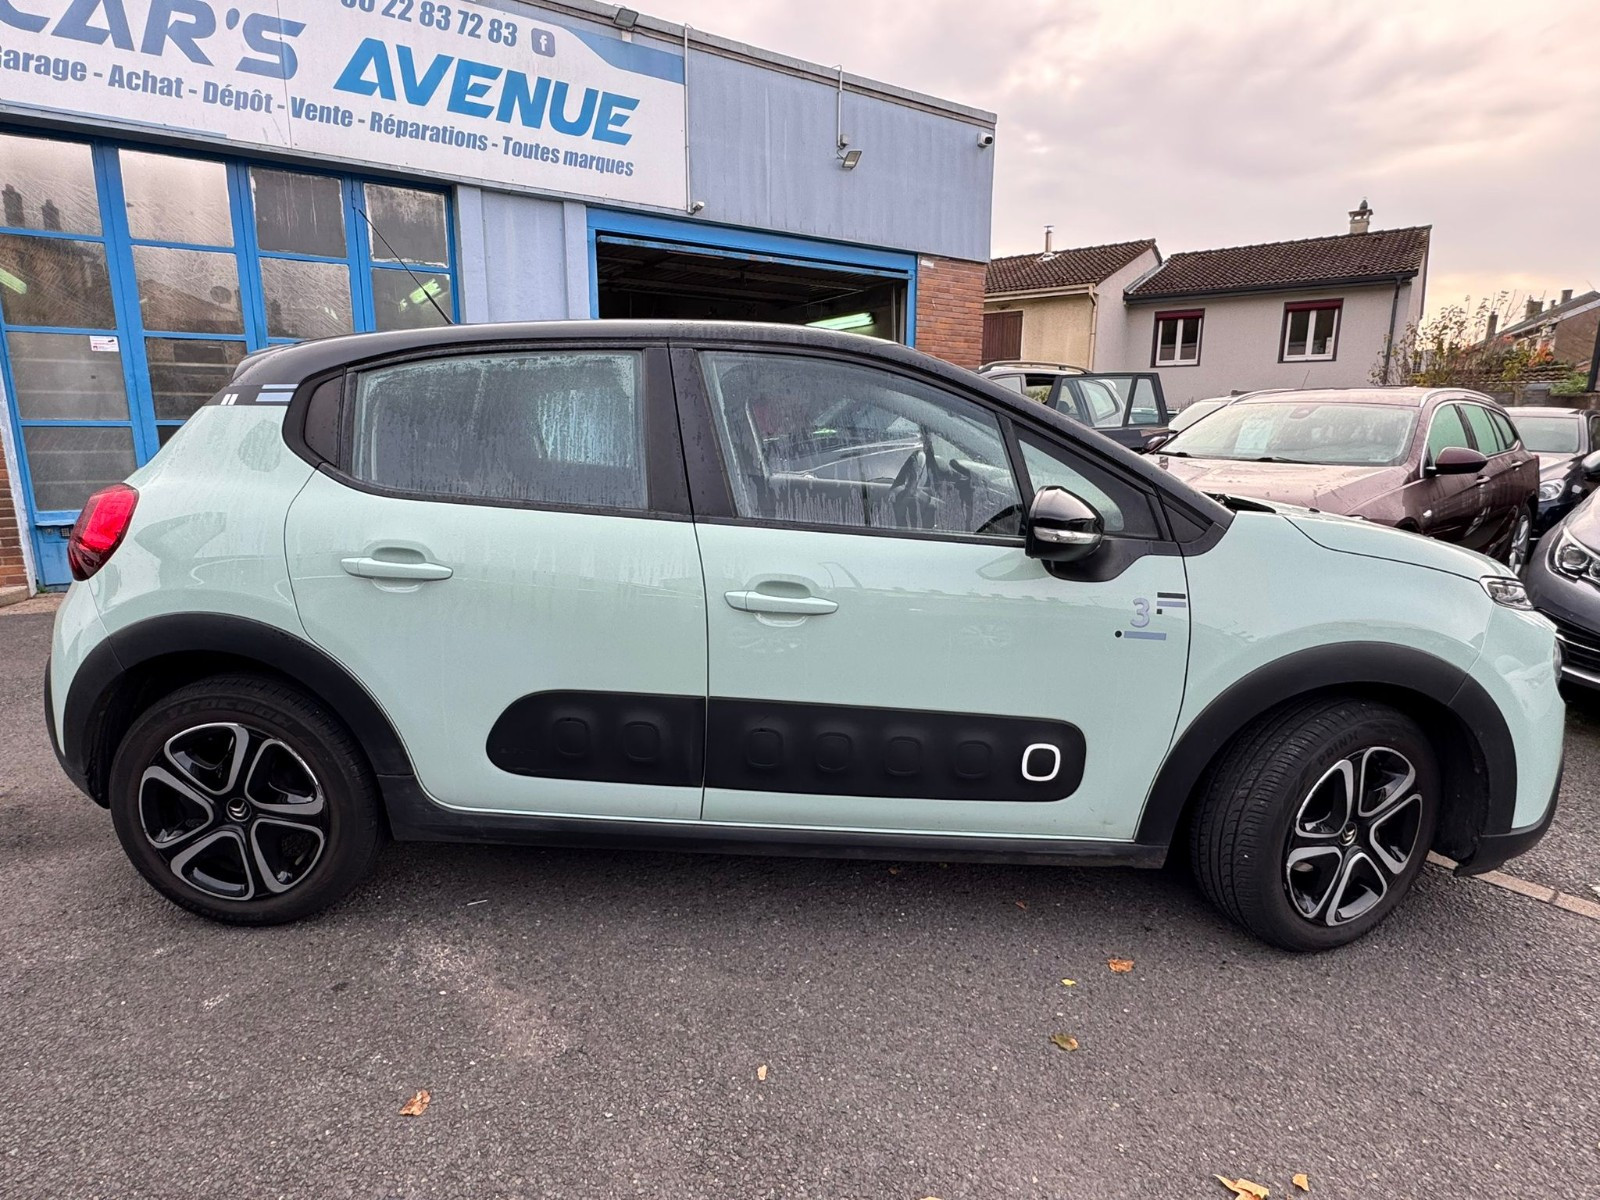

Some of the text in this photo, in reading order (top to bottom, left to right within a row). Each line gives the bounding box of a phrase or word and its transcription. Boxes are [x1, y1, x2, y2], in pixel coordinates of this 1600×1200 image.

[381, 0, 414, 23] 22
[419, 1, 452, 31] 83
[457, 10, 484, 39] 72
[487, 18, 518, 47] 83
[0, 46, 87, 82] arage
[107, 64, 184, 99] Achat
[202, 80, 273, 114] Dépôt
[290, 96, 354, 128] Vente
[369, 111, 489, 152] Réparations
[502, 136, 560, 164] Toutes
[562, 150, 634, 177] marques
[332, 37, 641, 146] AVENUE
